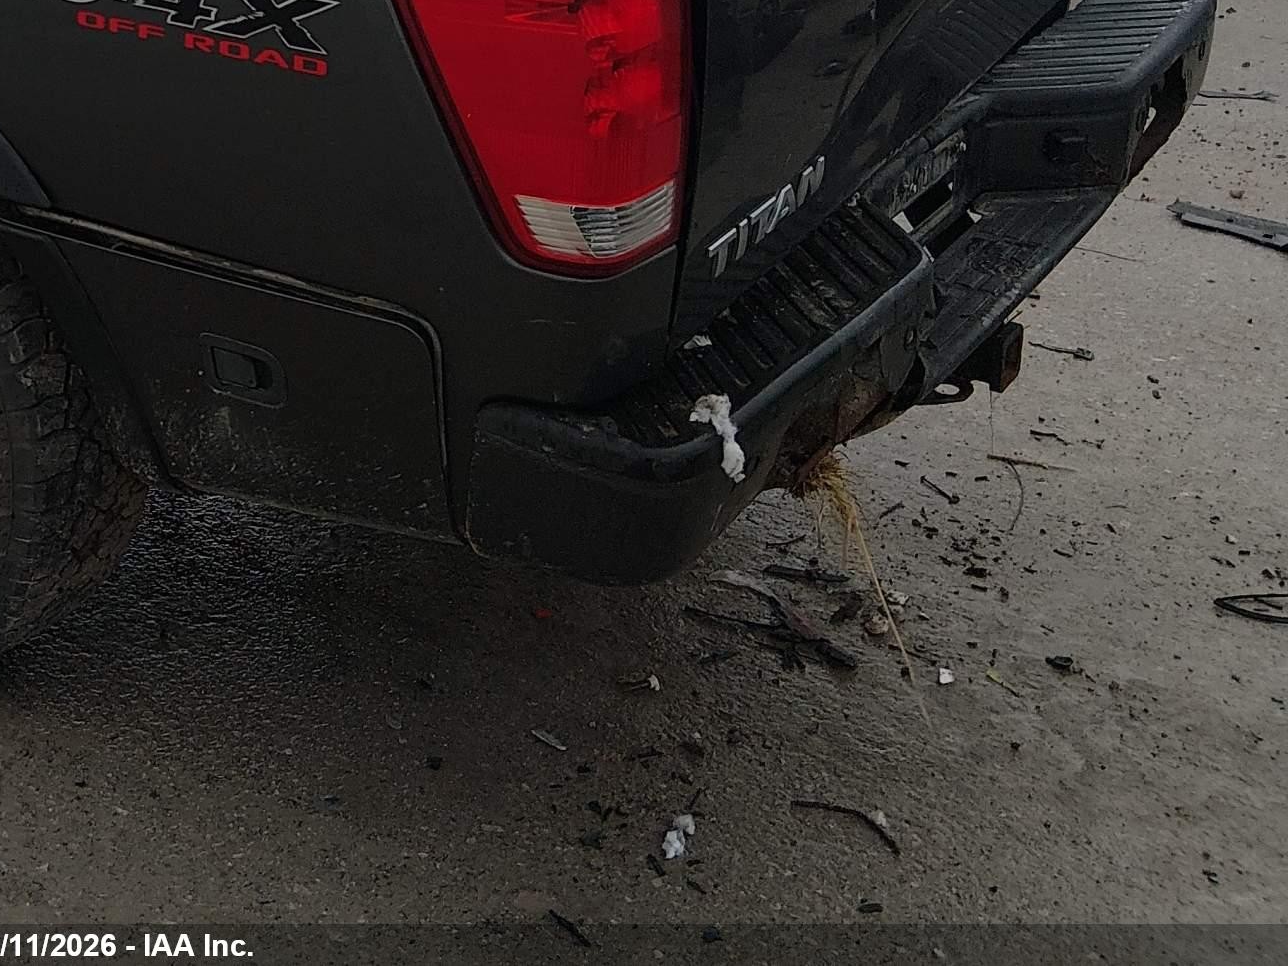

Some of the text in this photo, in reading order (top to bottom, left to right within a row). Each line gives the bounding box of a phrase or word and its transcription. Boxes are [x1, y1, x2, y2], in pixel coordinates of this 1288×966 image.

[76, 9, 328, 78] OFF ROAD
[708, 155, 825, 279] TITAN
